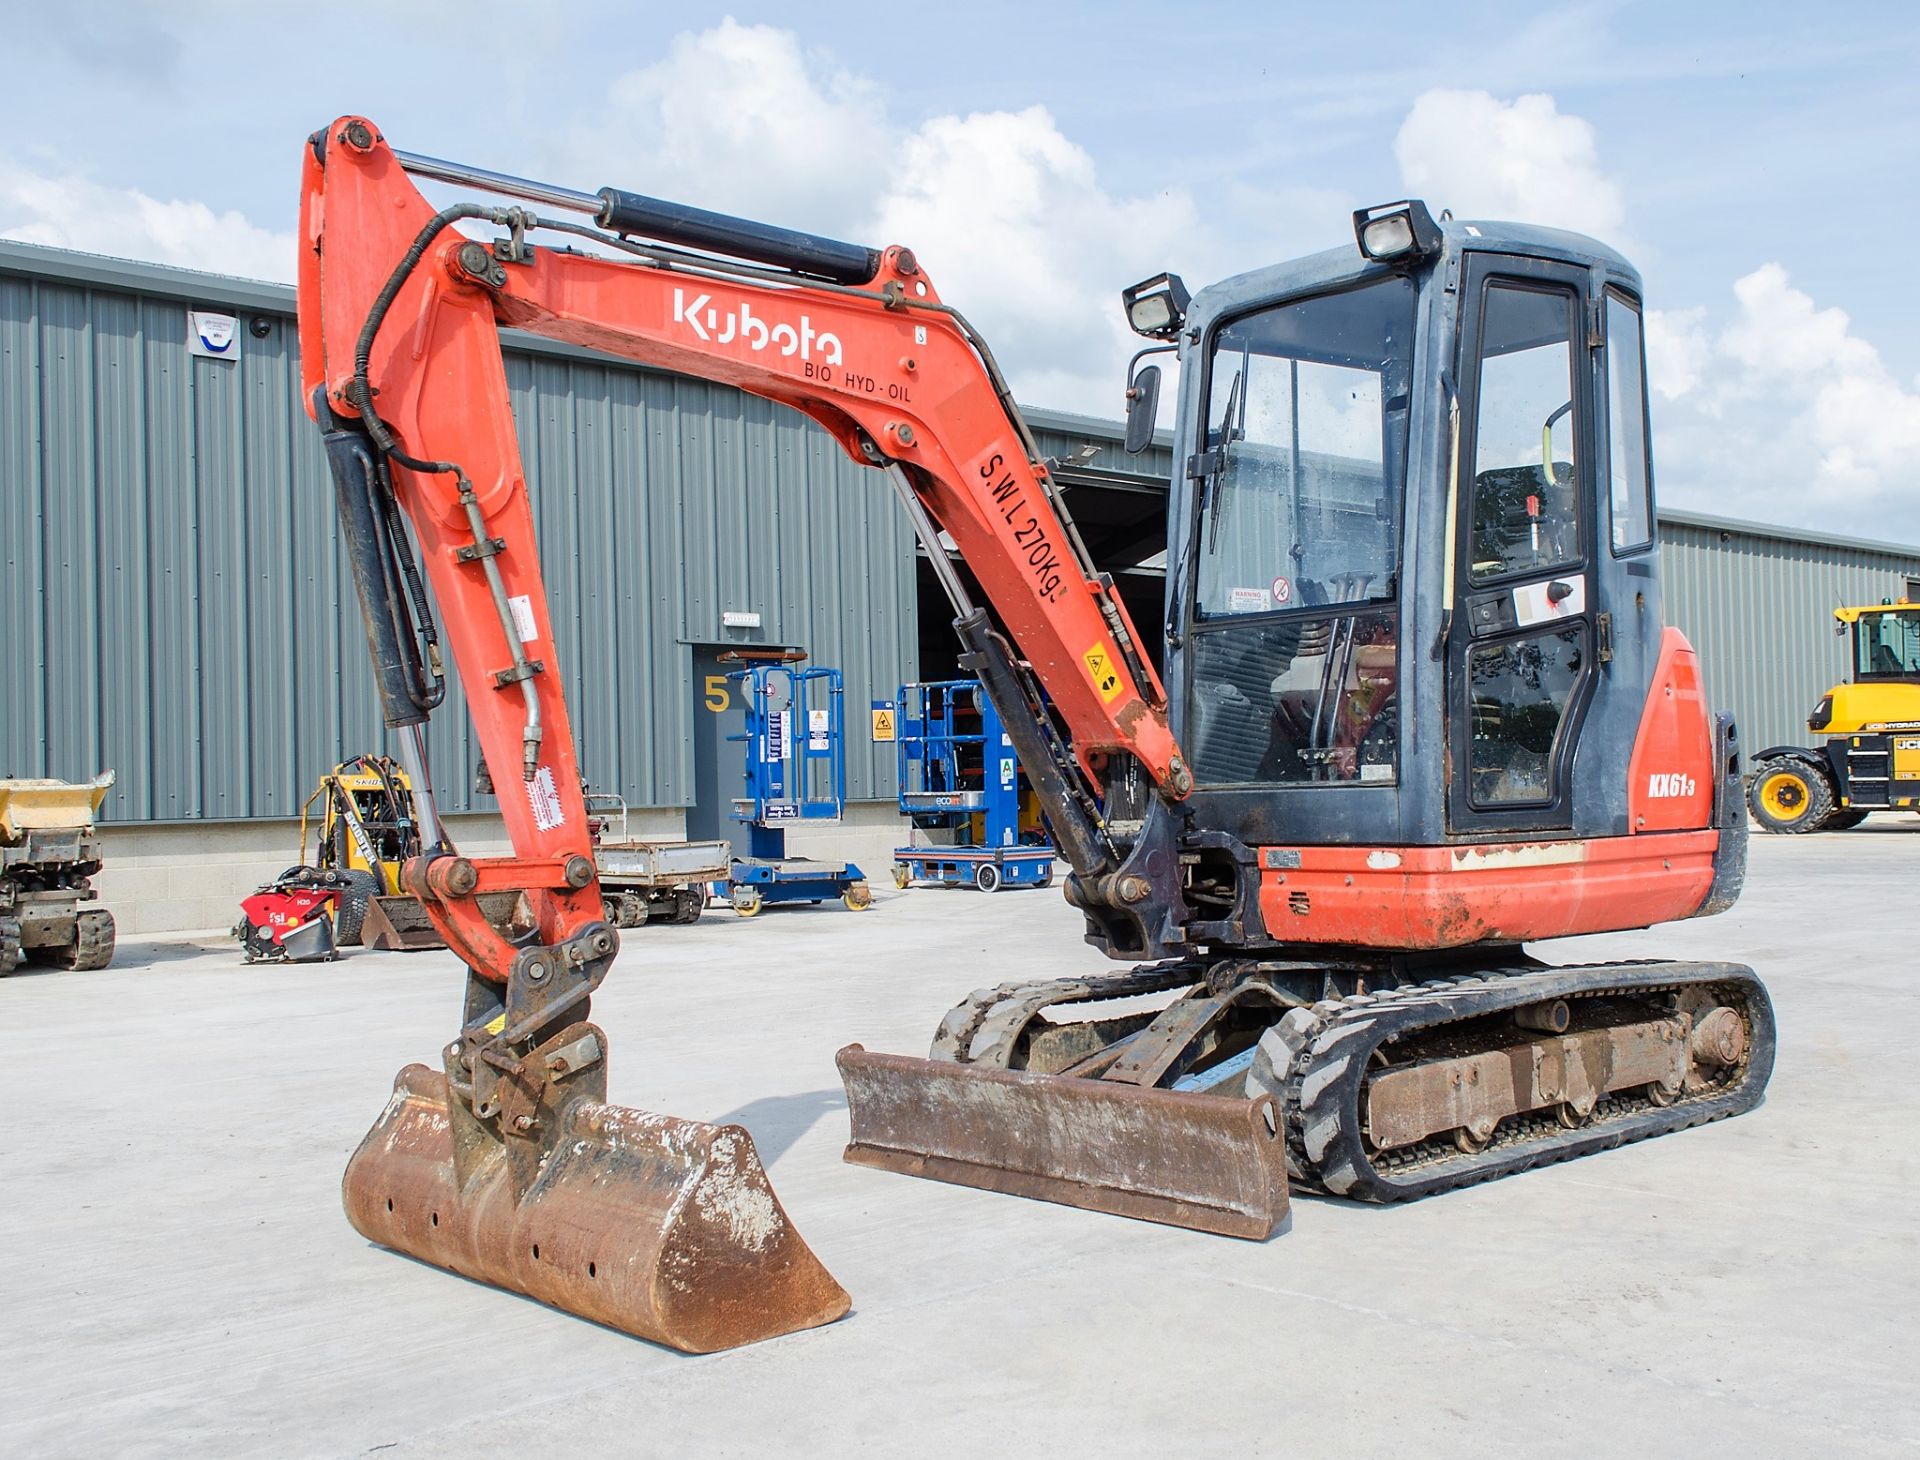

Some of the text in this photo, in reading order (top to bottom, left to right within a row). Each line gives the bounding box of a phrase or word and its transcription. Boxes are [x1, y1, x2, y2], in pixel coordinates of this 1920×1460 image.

[674, 288, 842, 366] Kubota
[805, 363, 831, 382] BIO
[846, 374, 875, 393] HYD
[888, 384, 911, 402] OIL
[705, 675, 730, 712] 5
[1648, 773, 1696, 798] KX61-3
[344, 811, 377, 865] SKIDSTER
